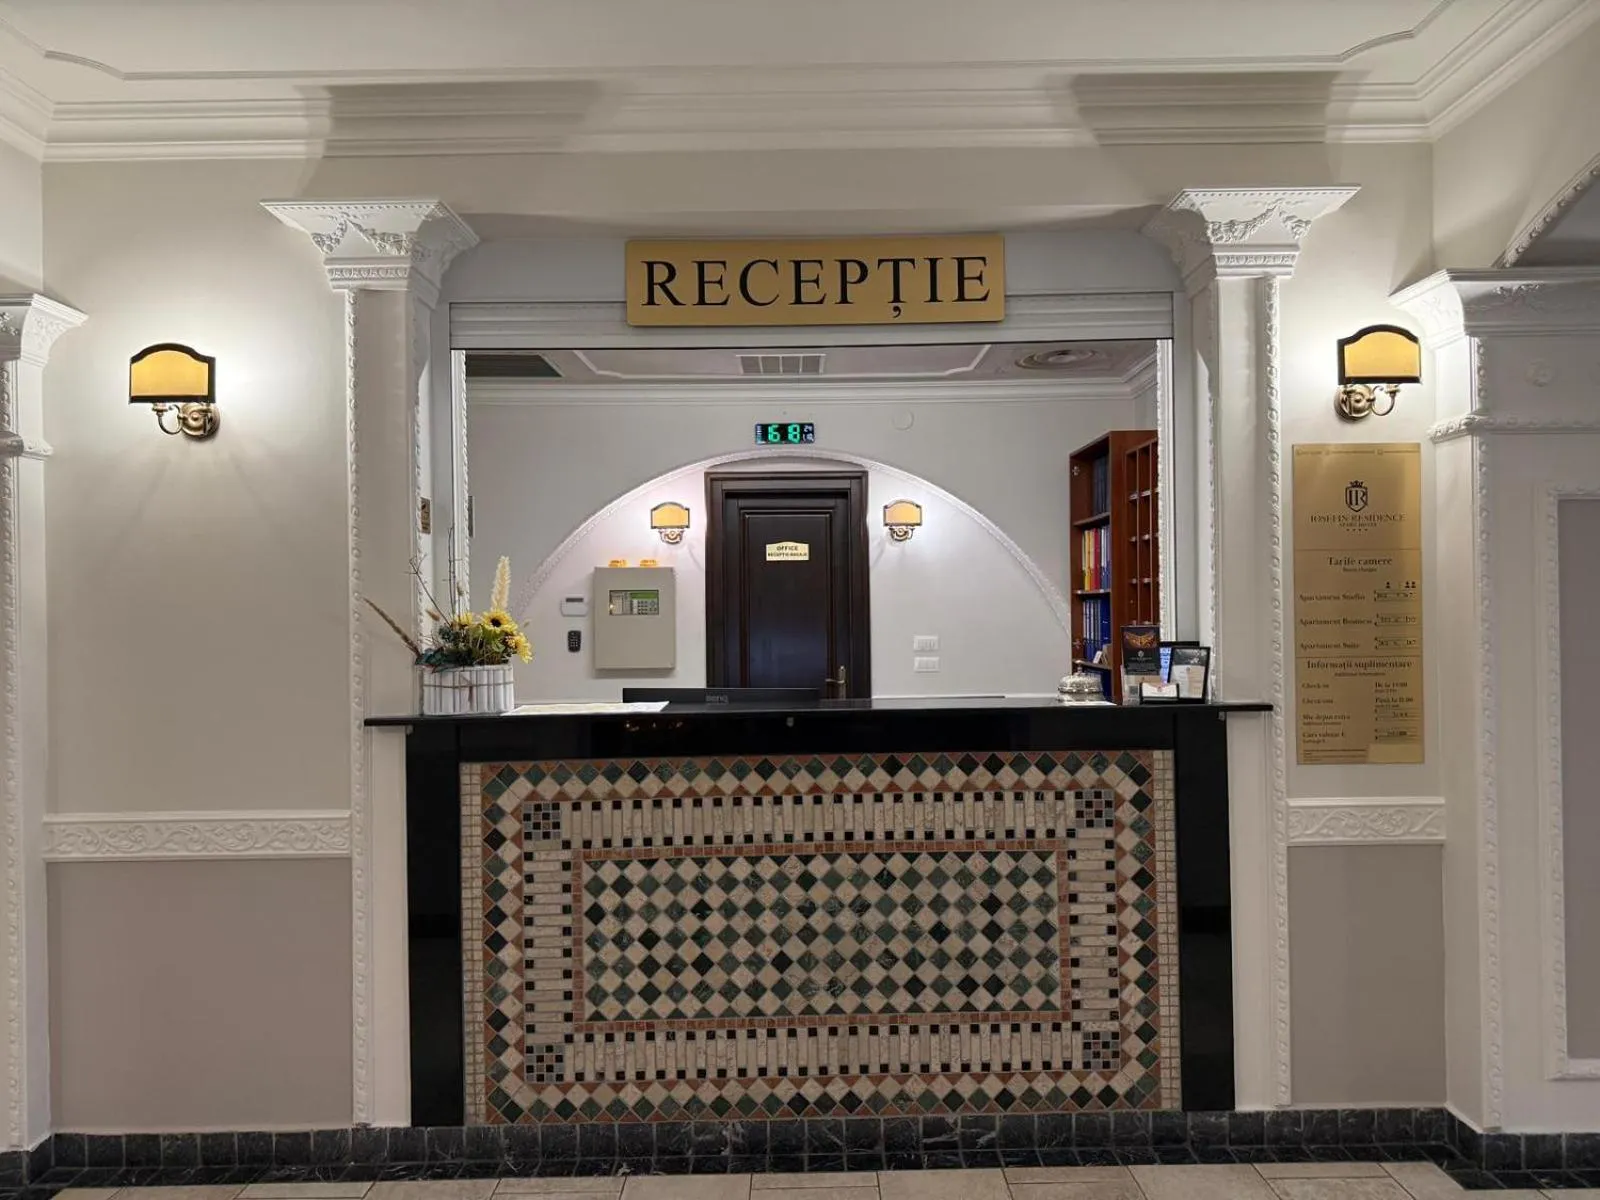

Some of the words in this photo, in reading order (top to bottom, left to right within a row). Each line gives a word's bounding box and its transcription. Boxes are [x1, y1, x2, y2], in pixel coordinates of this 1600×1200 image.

[641, 256, 990, 318] RECEPȚIE
[1351, 513, 1407, 522] RESIDENCE
[1328, 556, 1355, 566] Tarife
[1358, 557, 1393, 565] camere
[1354, 660, 1412, 670] suplimentare
